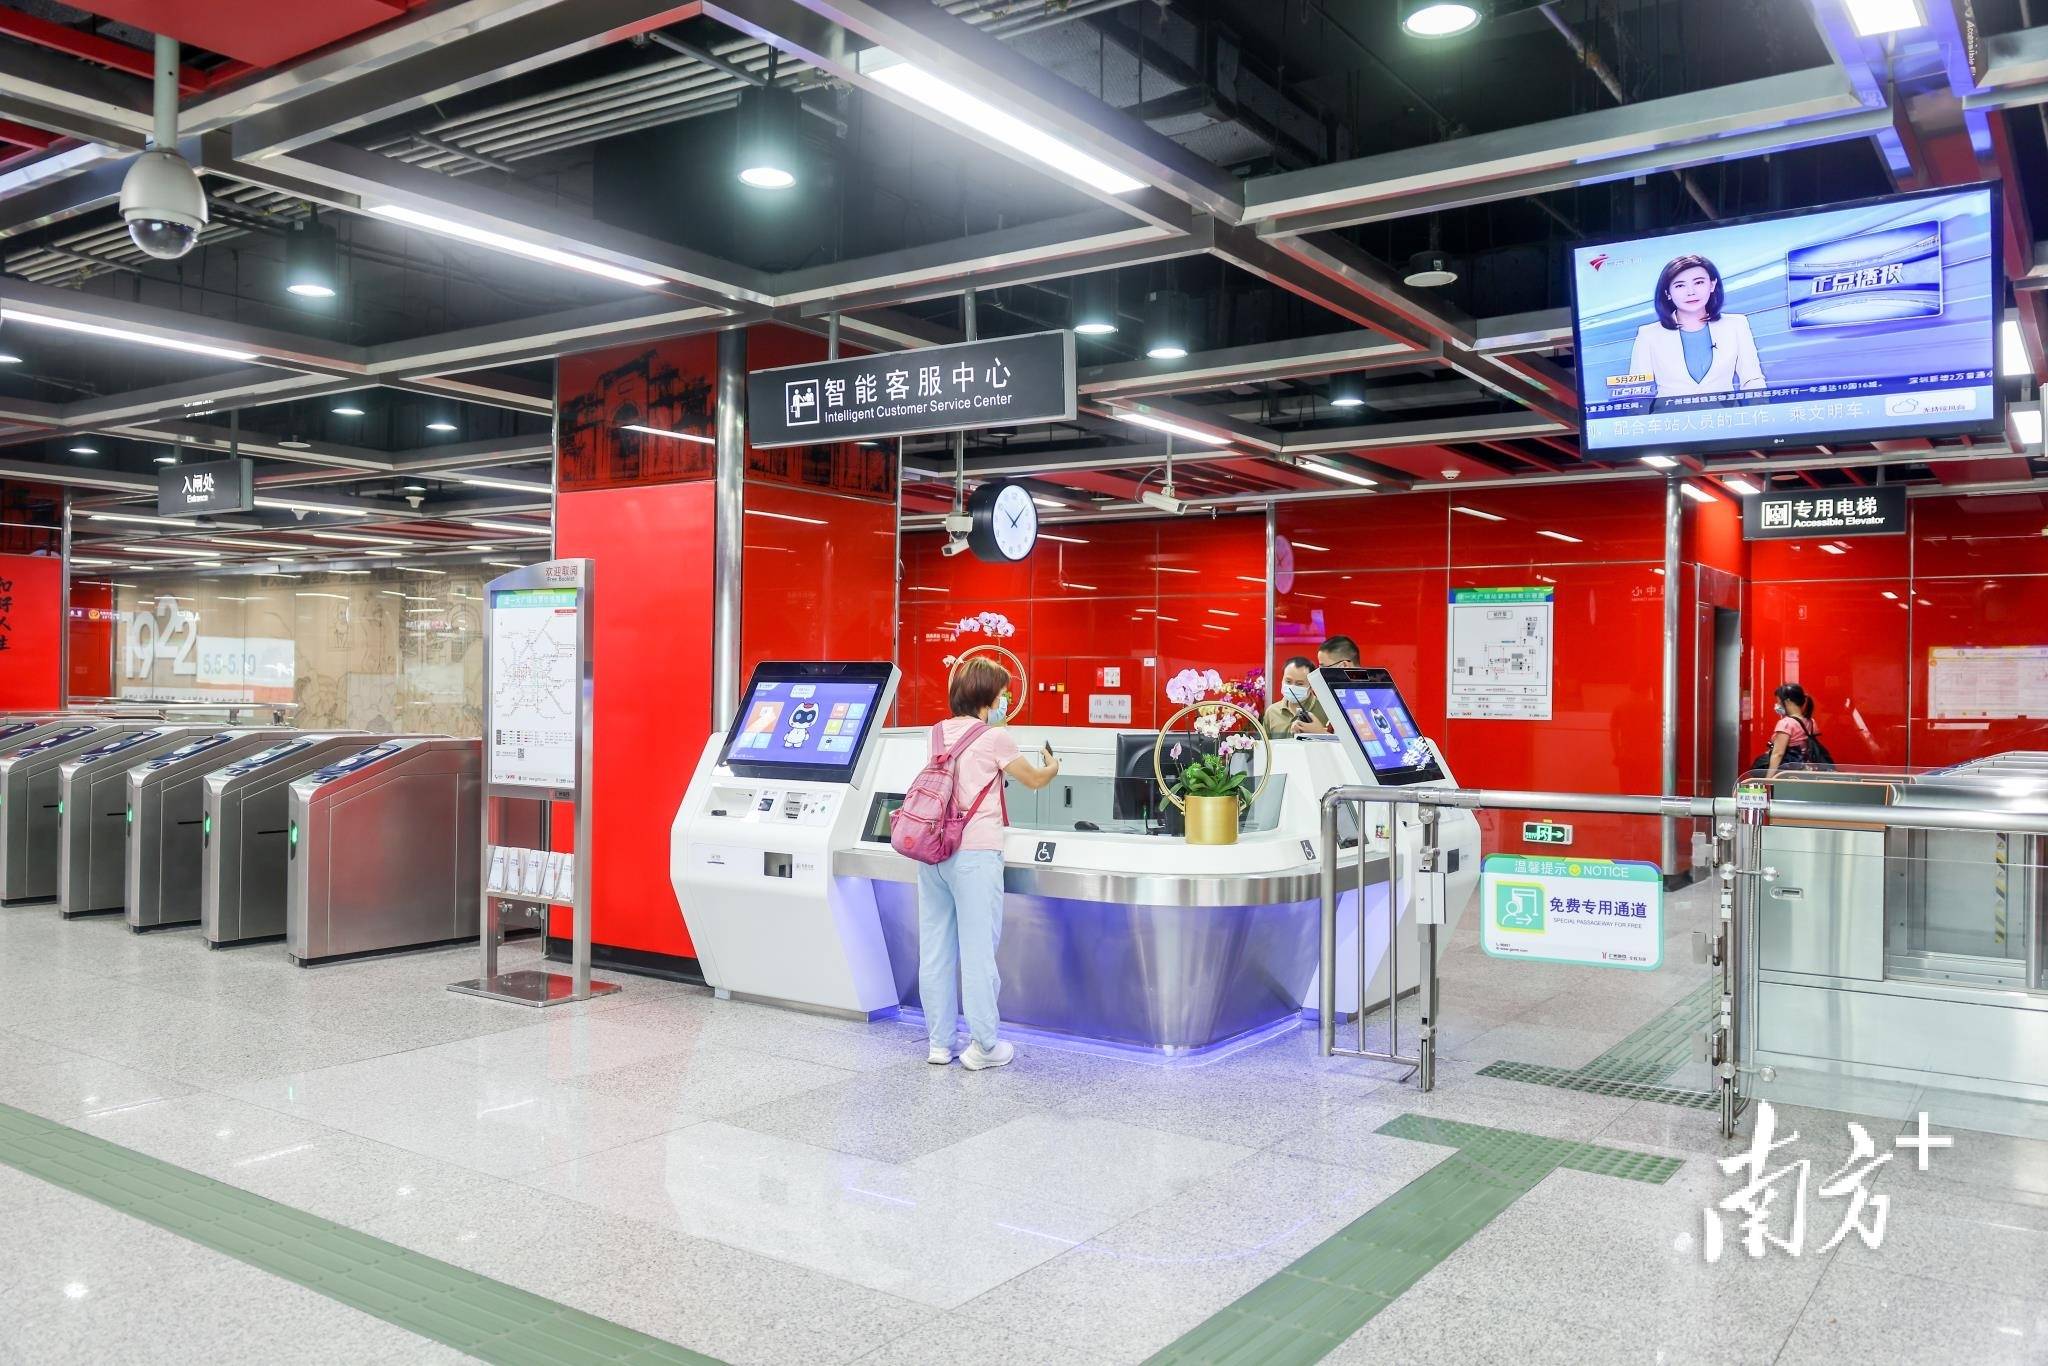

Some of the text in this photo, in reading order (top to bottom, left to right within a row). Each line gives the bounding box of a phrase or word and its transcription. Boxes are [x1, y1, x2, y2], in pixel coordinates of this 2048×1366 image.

[1811, 262, 1905, 296] 正点播报
[824, 357, 1011, 408] 智能客服中心
[1615, 374, 1646, 384] 5月27日
[824, 393, 1012, 423] Intelligent Customer Service Center
[182, 472, 215, 493] 入闸处
[1793, 496, 1877, 518] 专用电梯
[1793, 516, 1886, 528] Accessible Elevator
[119, 594, 199, 679] 1922
[1514, 860, 1630, 878] 温馨提示 NOTICE
[1550, 896, 1647, 918] 免费专用通道
[1553, 917, 1575, 925] SPECIAL
